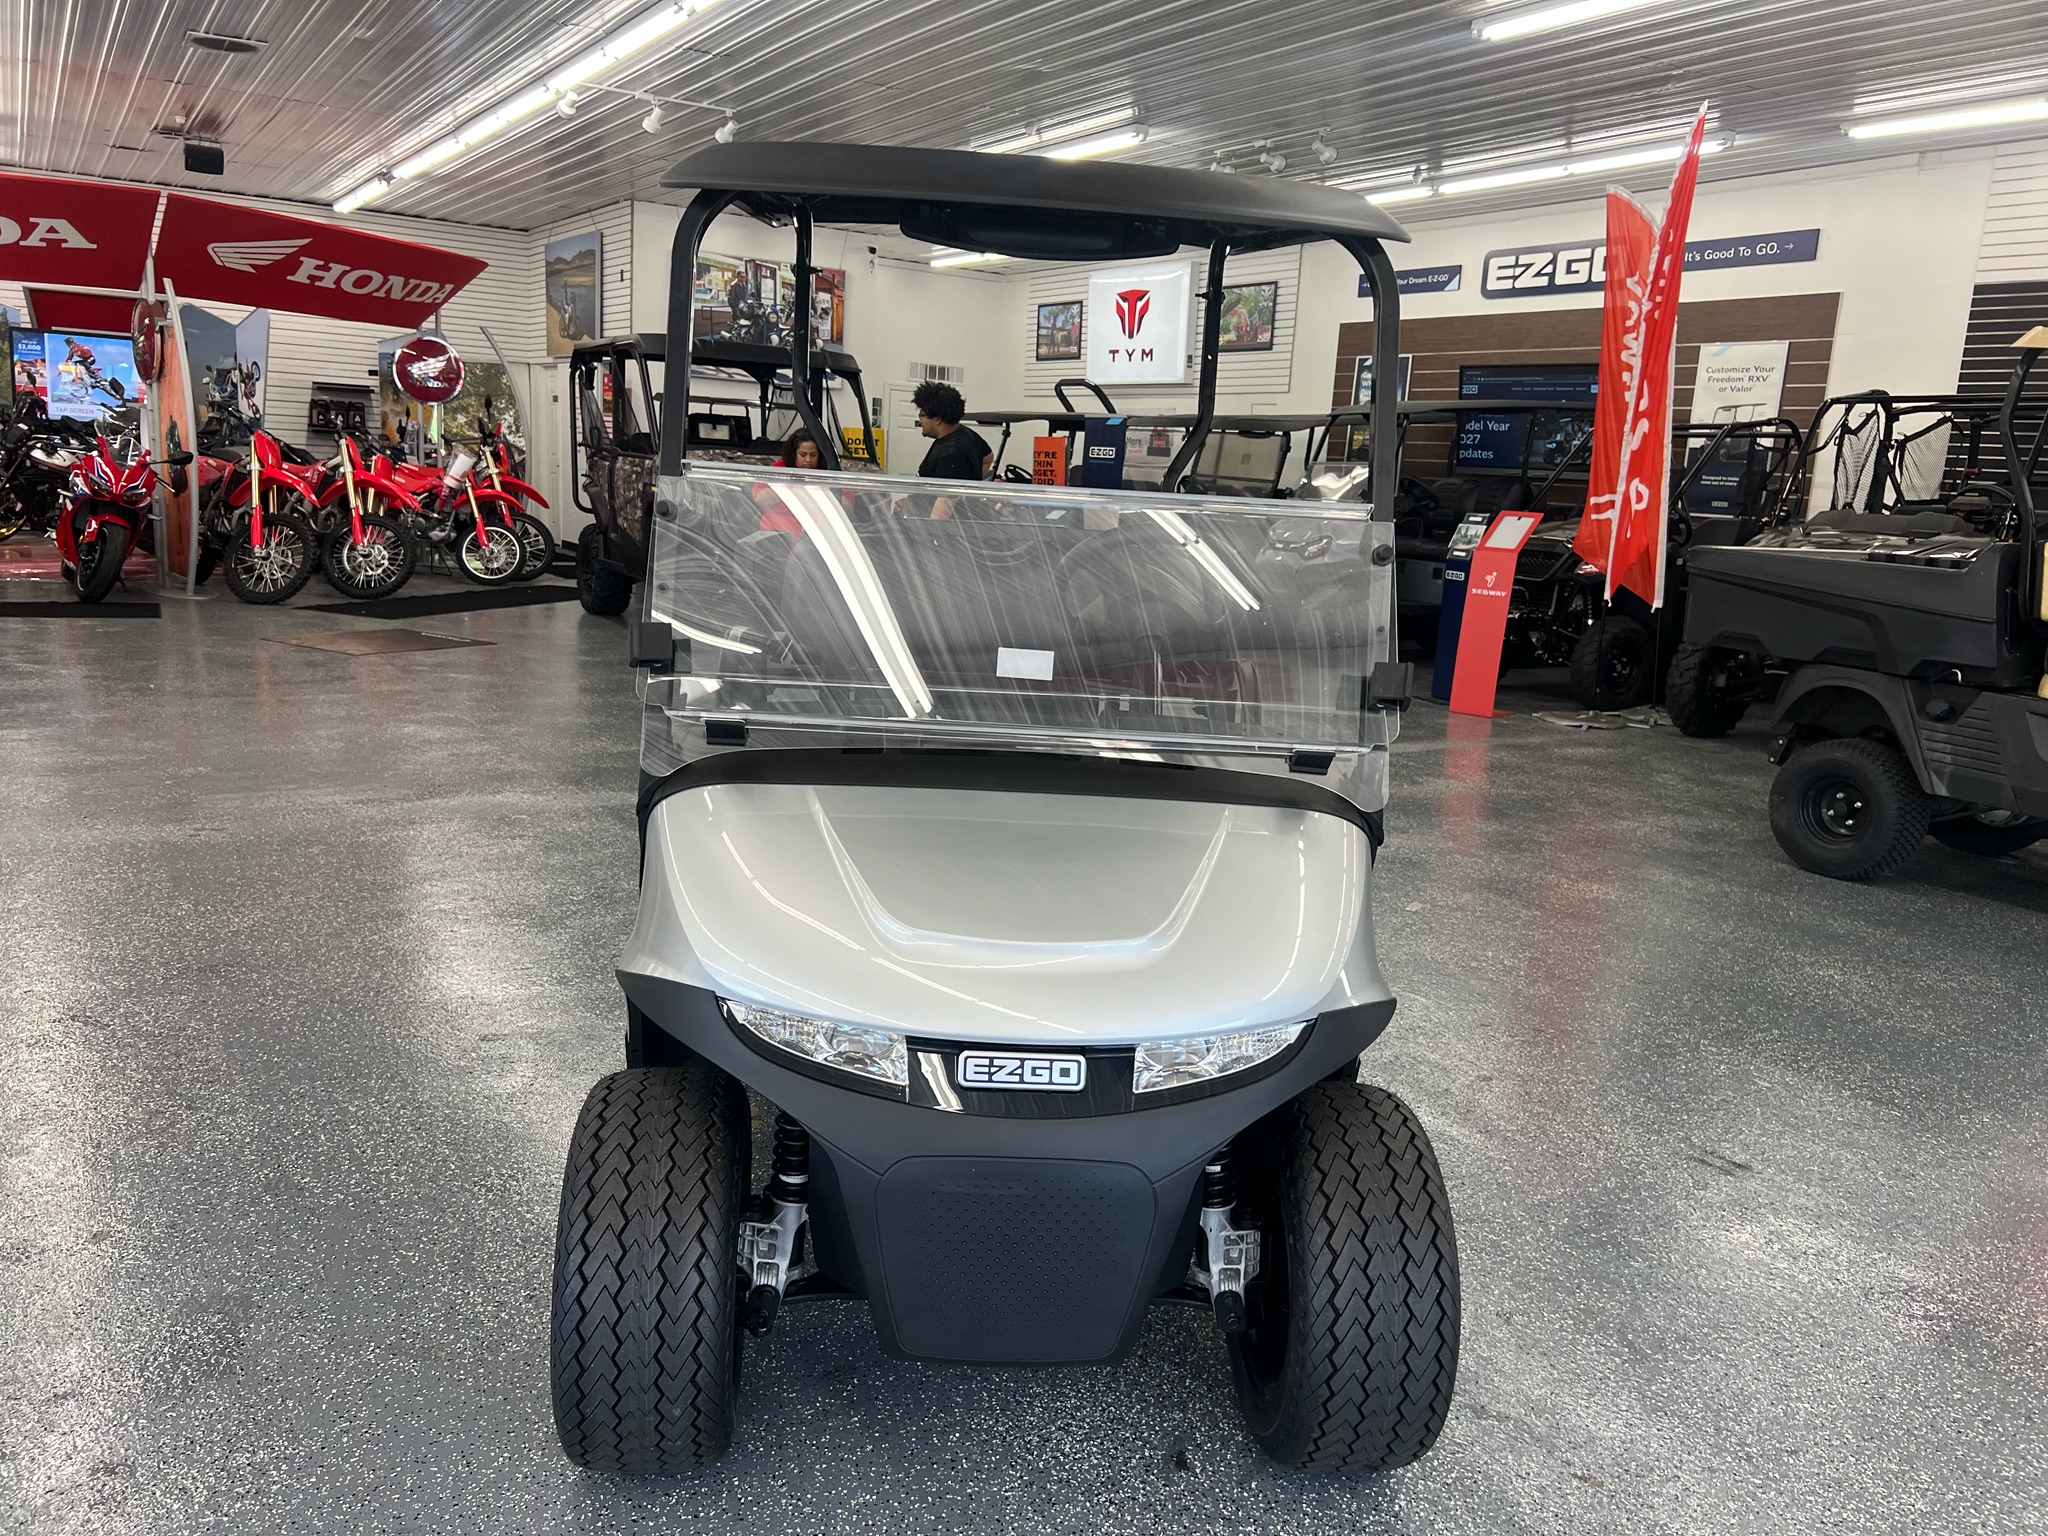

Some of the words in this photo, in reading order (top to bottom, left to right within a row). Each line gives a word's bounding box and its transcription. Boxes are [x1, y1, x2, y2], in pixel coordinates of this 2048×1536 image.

[1684, 251, 1701, 262] It's
[1704, 247, 1735, 260] Good
[1738, 246, 1752, 257] To
[1755, 242, 1781, 256] GO.
[286, 256, 455, 304] HONDA
[1397, 278, 1408, 286] our
[1409, 275, 1428, 285] Dream
[1108, 348, 1154, 362] TYM
[1706, 365, 1751, 375] Customize
[1753, 365, 1776, 374] Your
[1707, 376, 1745, 384] Freedom
[1748, 375, 1769, 383] RXV
[1730, 385, 1755, 393] Valor
[1465, 420, 1484, 431] del
[1486, 420, 1510, 431] Year
[847, 437, 880, 447] DOT
[1460, 434, 1481, 444] 027
[1460, 448, 1494, 459] pdates
[1034, 460, 1053, 468] THIN
[1034, 469, 1057, 477] GET.
[1471, 588, 1507, 597] SEGWAY
